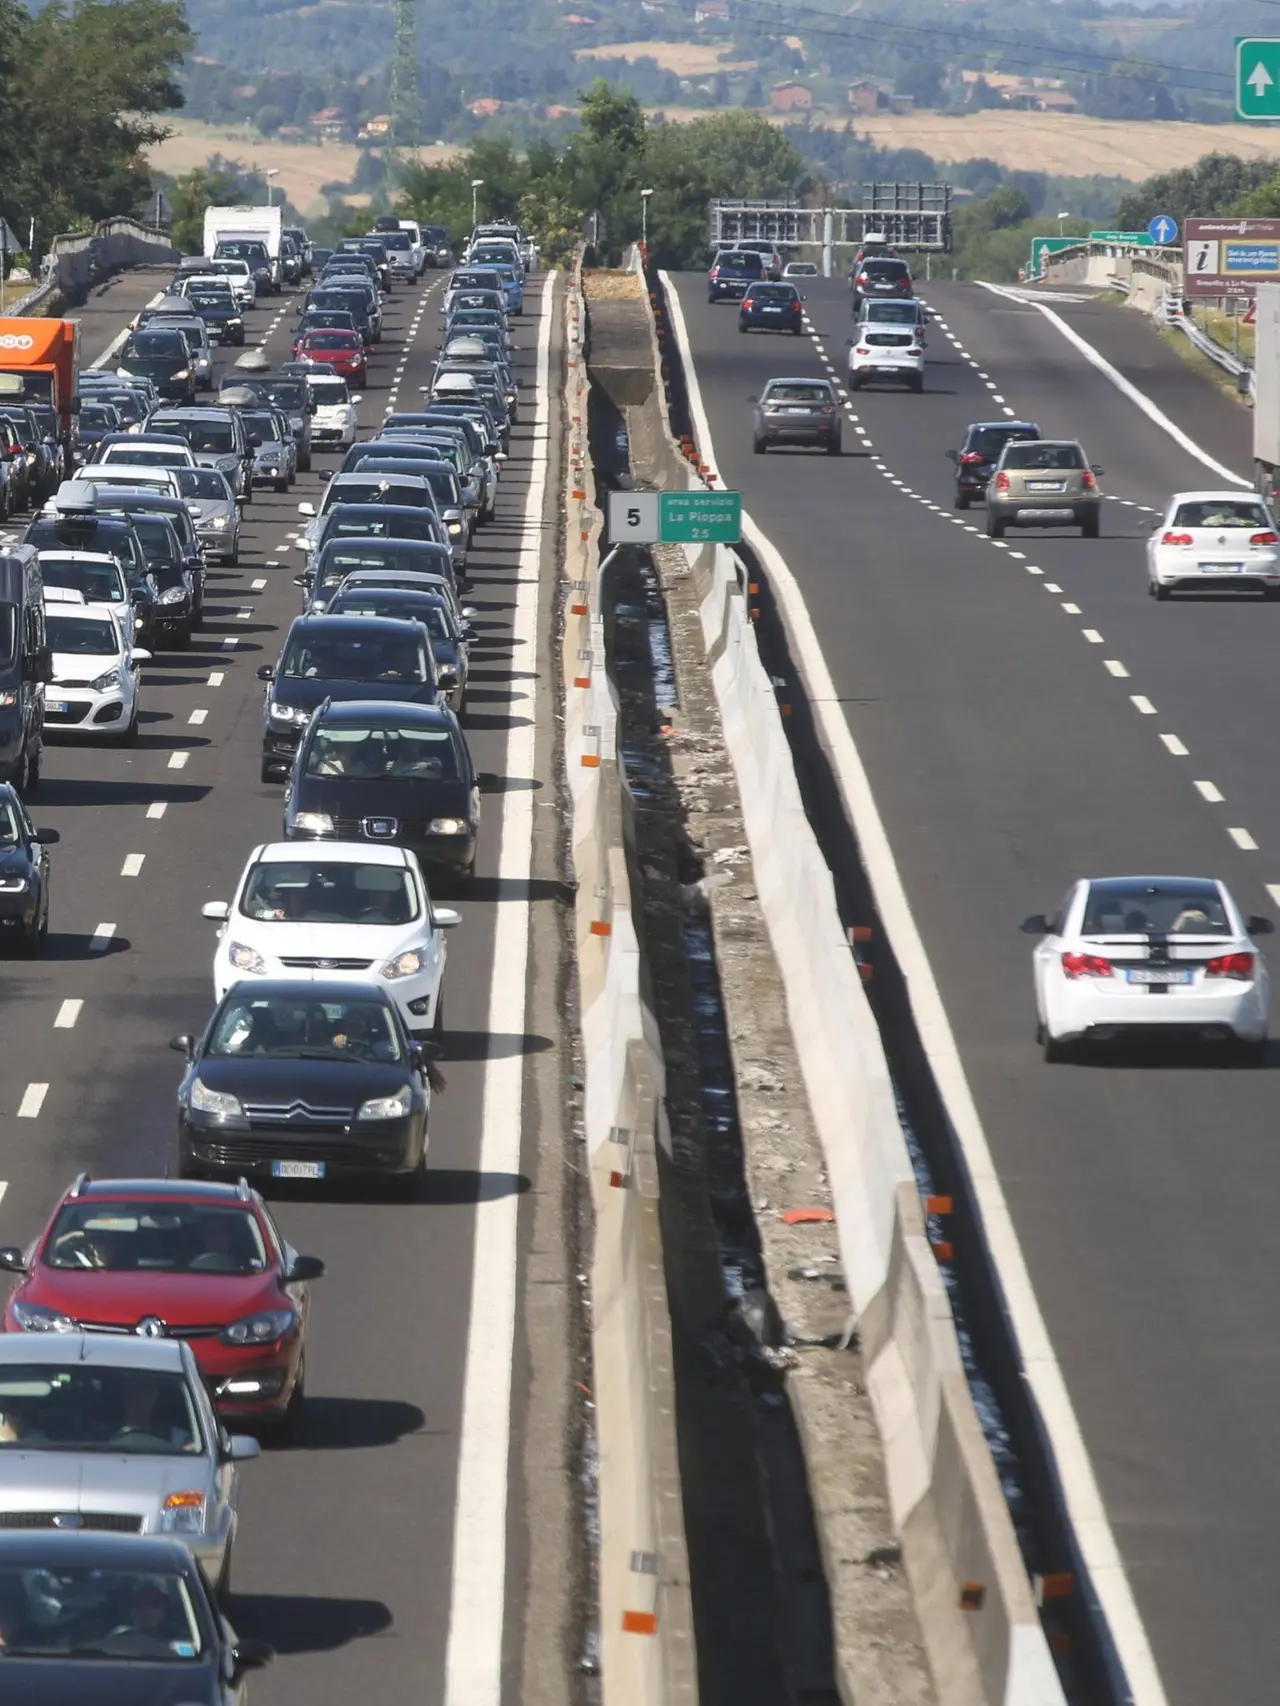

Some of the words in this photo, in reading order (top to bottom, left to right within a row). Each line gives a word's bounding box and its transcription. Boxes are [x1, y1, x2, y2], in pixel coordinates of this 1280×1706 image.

[667, 498, 690, 506] area
[694, 498, 734, 506] servizio
[627, 508, 641, 527] 5
[669, 512, 684, 522] La
[689, 511, 732, 523] Pioppa
